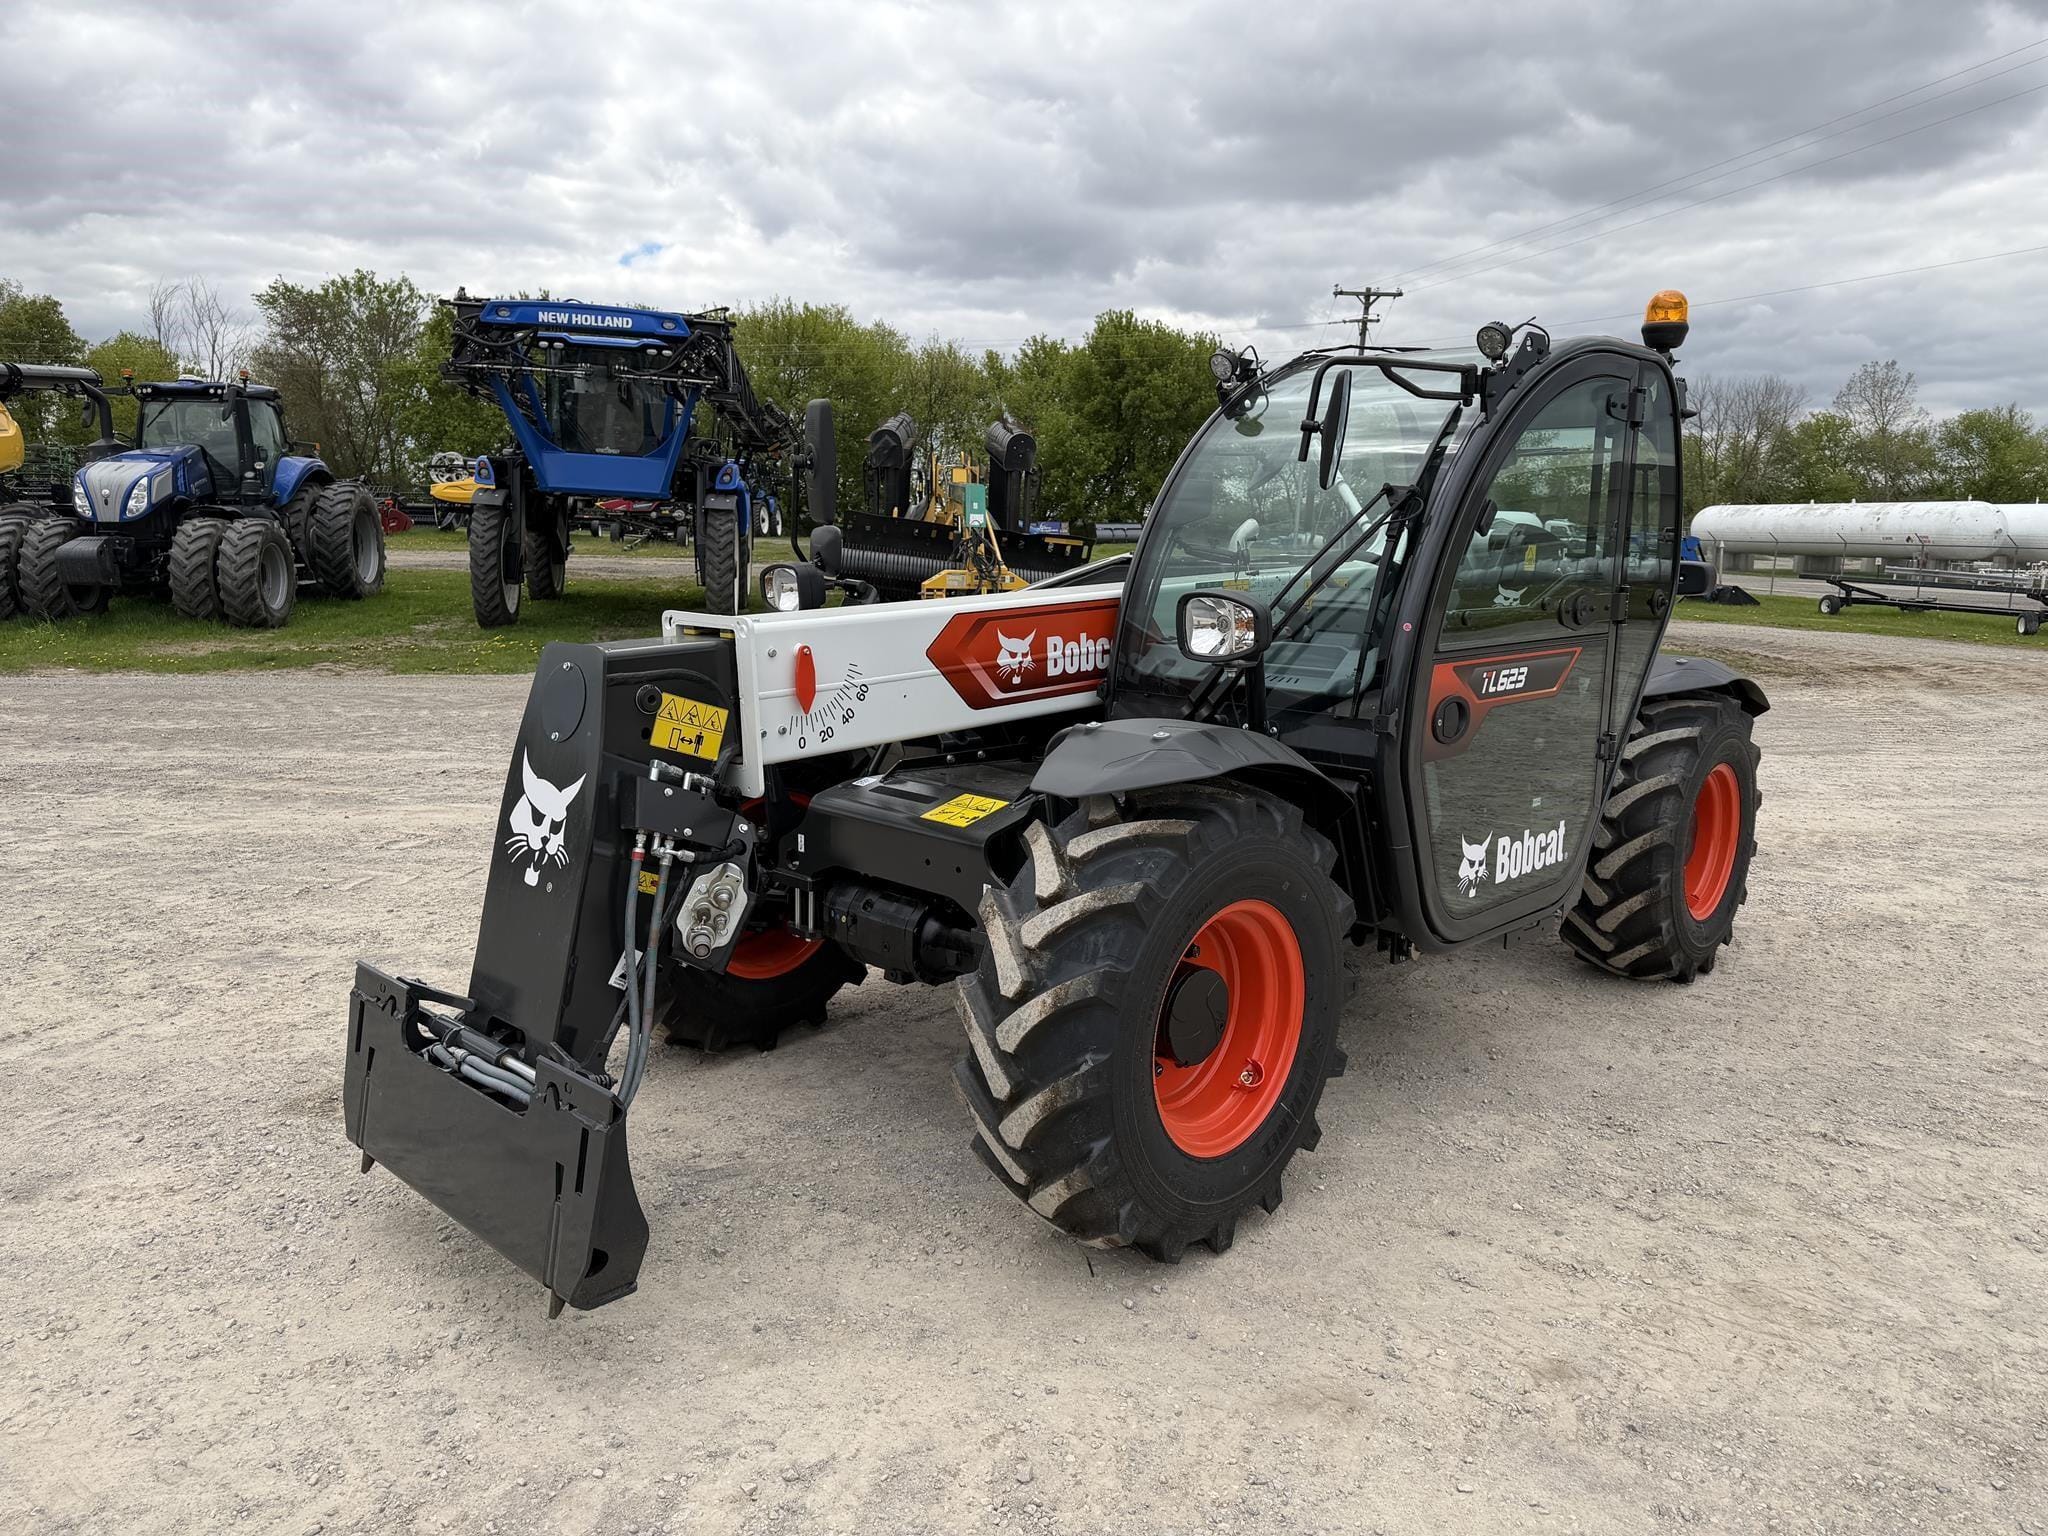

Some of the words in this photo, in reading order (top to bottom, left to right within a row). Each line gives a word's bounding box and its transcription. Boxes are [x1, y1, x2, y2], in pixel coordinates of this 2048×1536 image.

[538, 311, 569, 324] NEW
[572, 313, 633, 329] HOLLAND
[1046, 632, 1113, 677] Bobc
[798, 736, 807, 750] 0
[819, 726, 835, 743] 20
[841, 707, 855, 725] 40
[855, 683, 869, 702] 60
[1495, 820, 1566, 885] Bobcat
